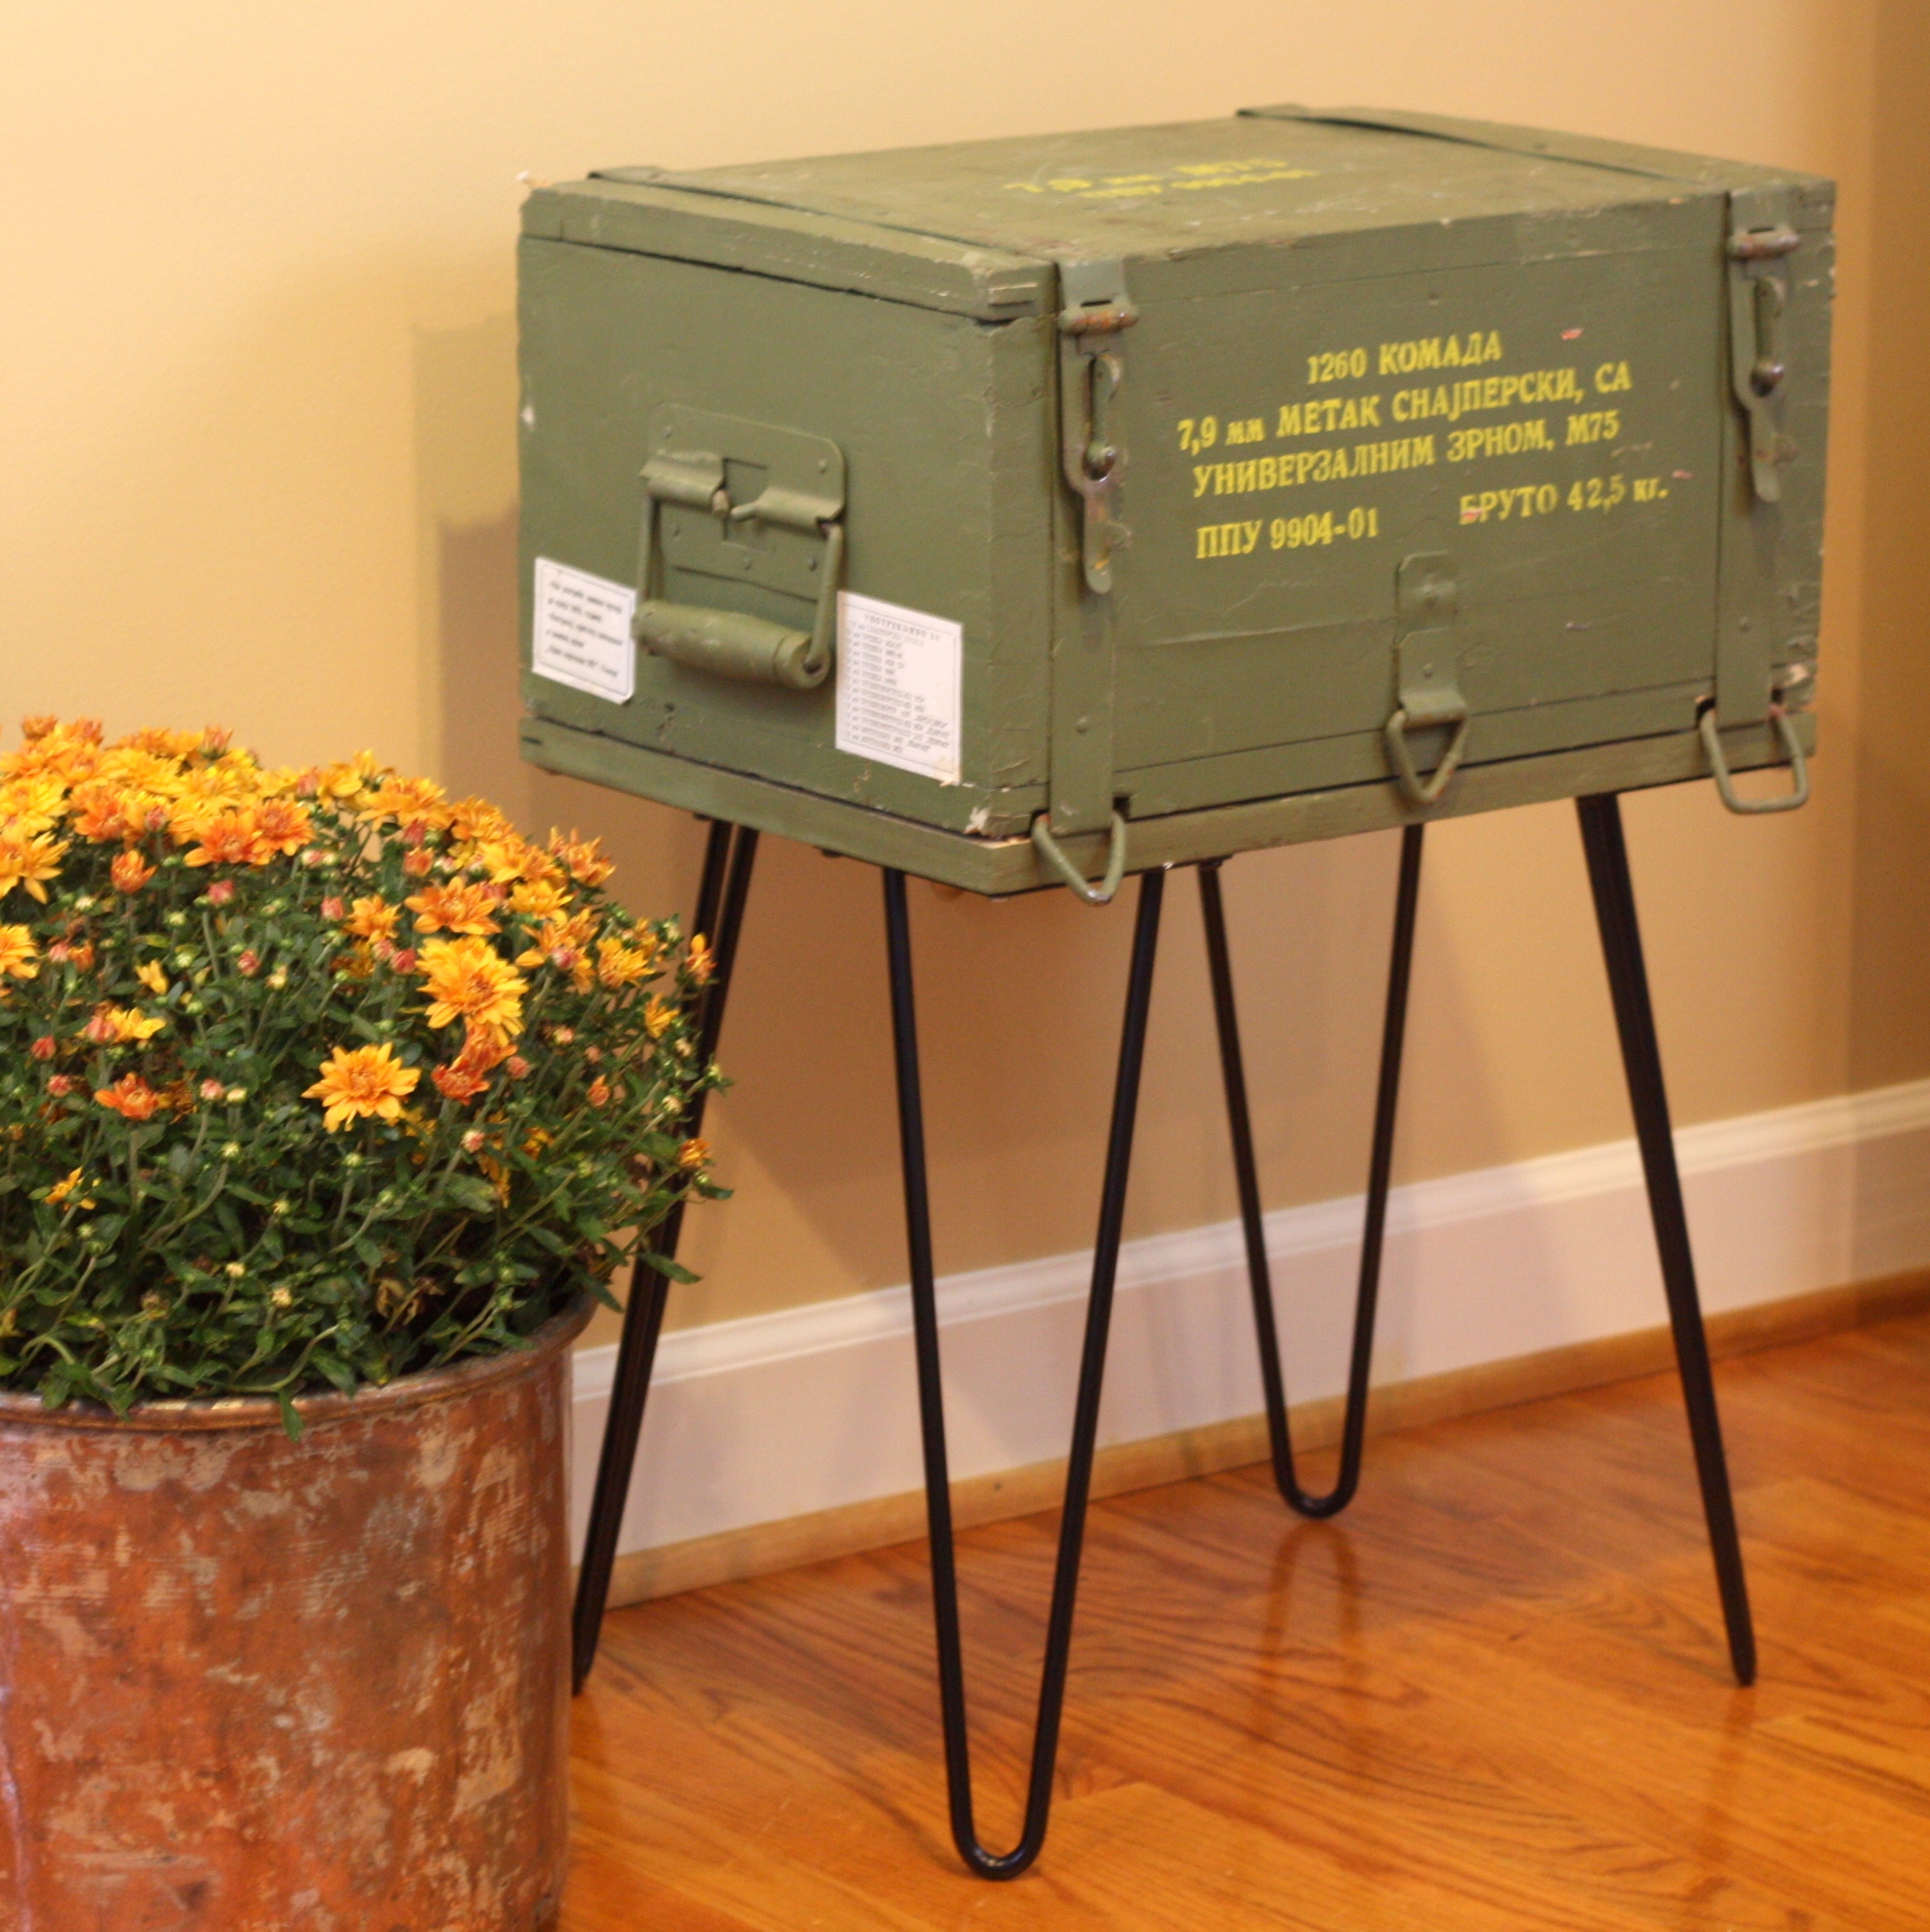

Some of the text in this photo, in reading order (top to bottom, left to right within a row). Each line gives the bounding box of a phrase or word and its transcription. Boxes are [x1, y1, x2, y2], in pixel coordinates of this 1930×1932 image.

[1308, 330, 1503, 384] 1260 КОМАДА
[1178, 362, 1632, 455] 7,9 мм МЕТАК СНАЈПЕРСКИ, СА
[1192, 410, 1621, 497] УНИВЕРЗАЛНИМ ЗРНОМ, М75
[1196, 520, 1262, 559] ППУ
[1269, 507, 1379, 551] 9904-01
[1459, 482, 1558, 525] БРУТО
[1567, 473, 1626, 514] 42,5
